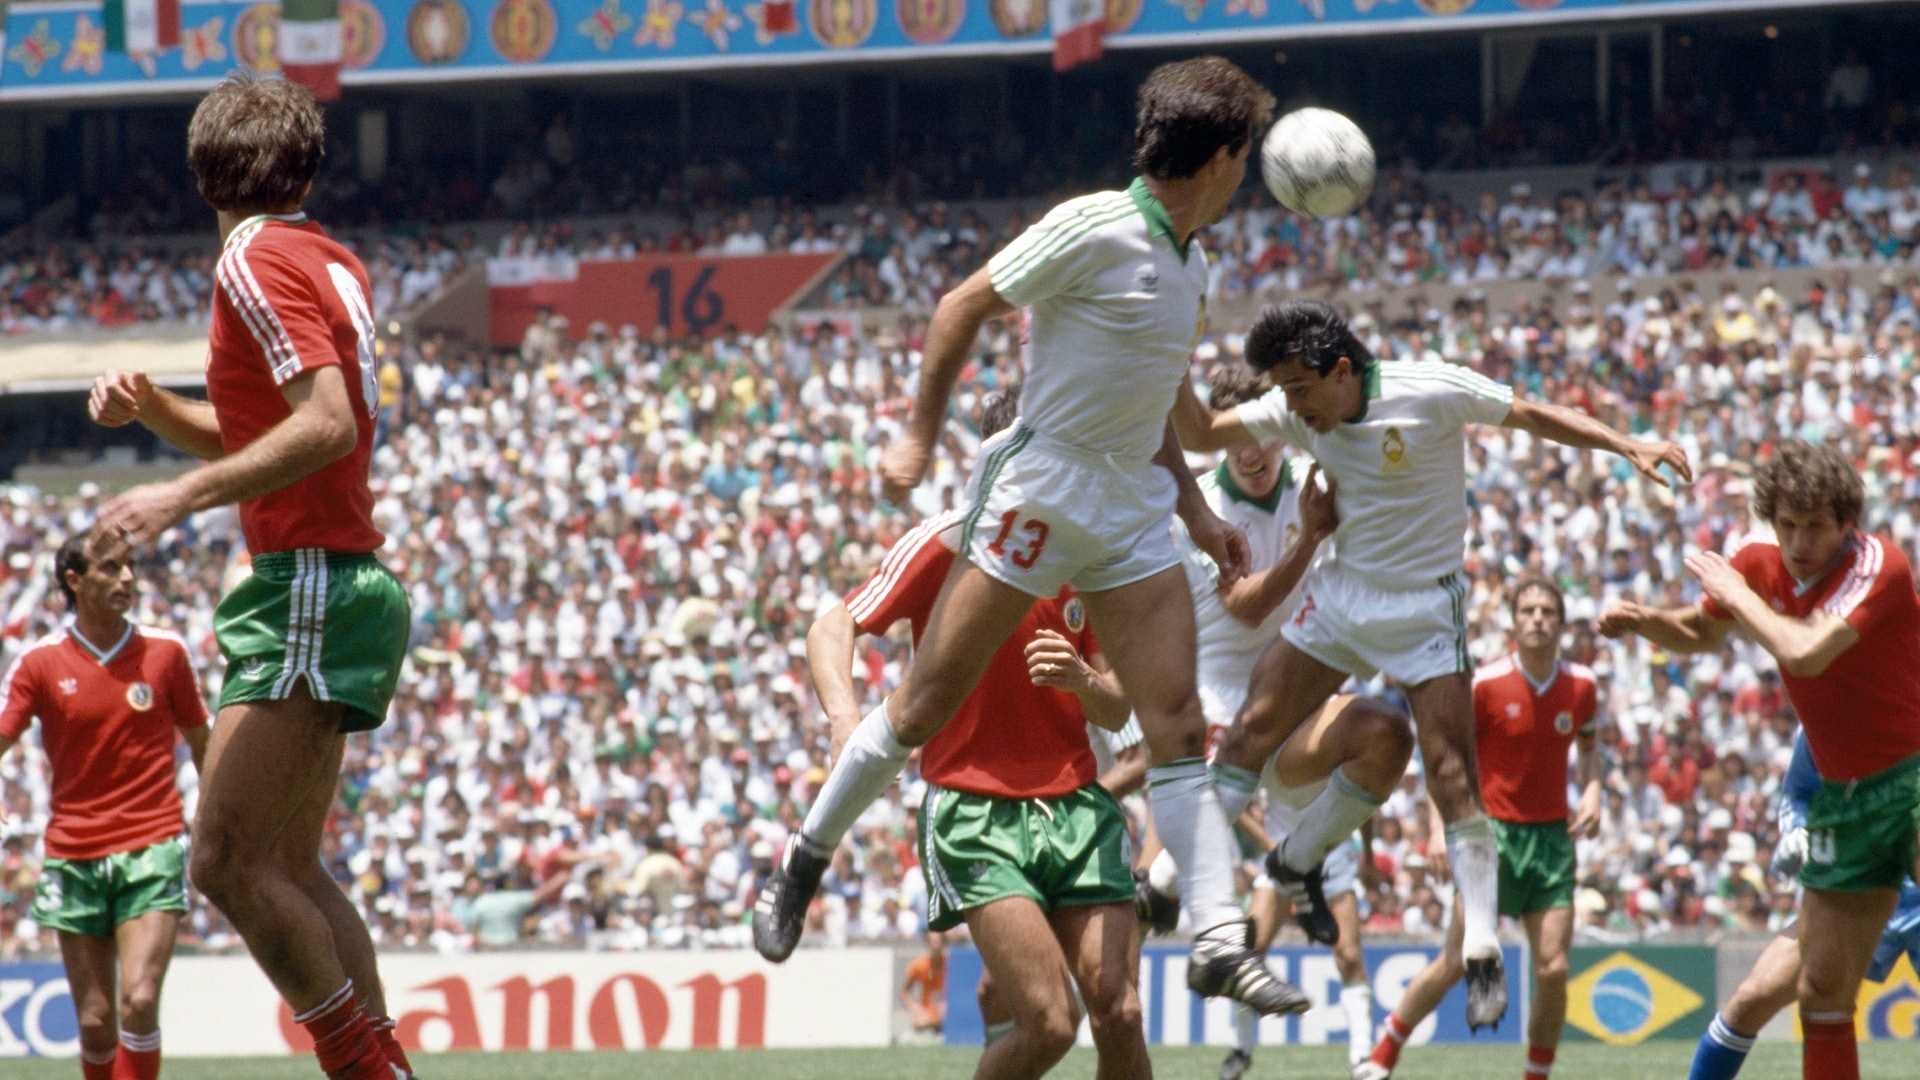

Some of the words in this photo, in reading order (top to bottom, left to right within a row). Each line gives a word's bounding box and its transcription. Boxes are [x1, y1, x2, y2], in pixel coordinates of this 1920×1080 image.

[647, 264, 725, 335] 16
[987, 509, 1049, 570] 13
[278, 972, 767, 1053] anon
